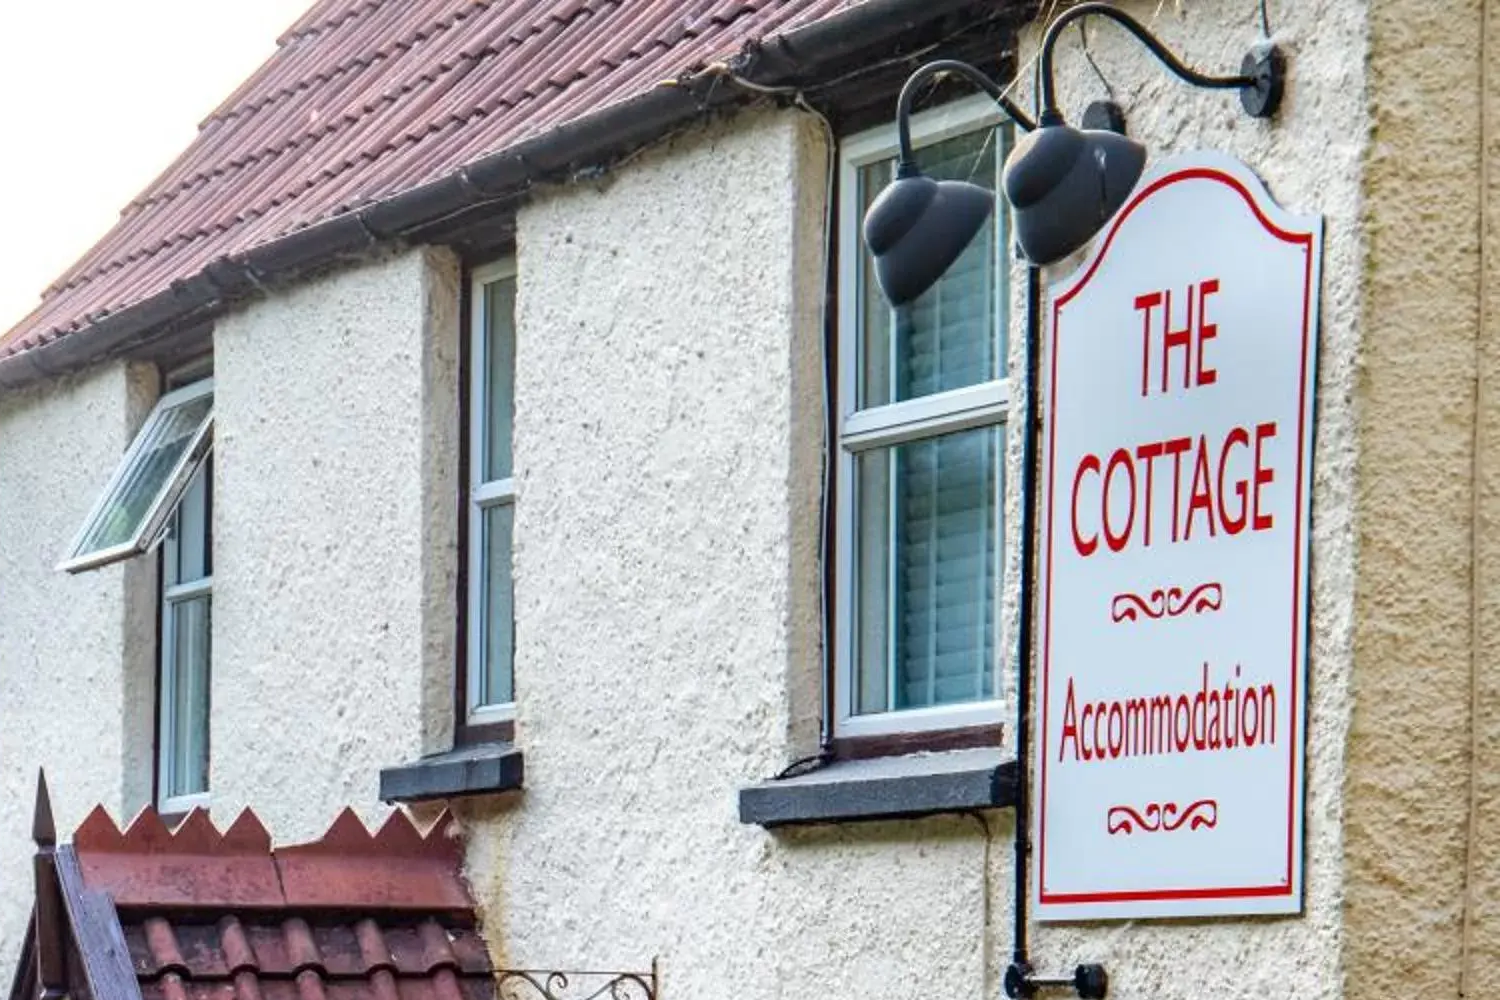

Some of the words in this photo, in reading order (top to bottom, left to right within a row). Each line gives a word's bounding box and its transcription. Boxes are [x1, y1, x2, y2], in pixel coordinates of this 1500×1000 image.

[1134, 278, 1221, 397] THE
[1071, 422, 1277, 557] COTTAGE
[1059, 662, 1276, 763] Accommodation
